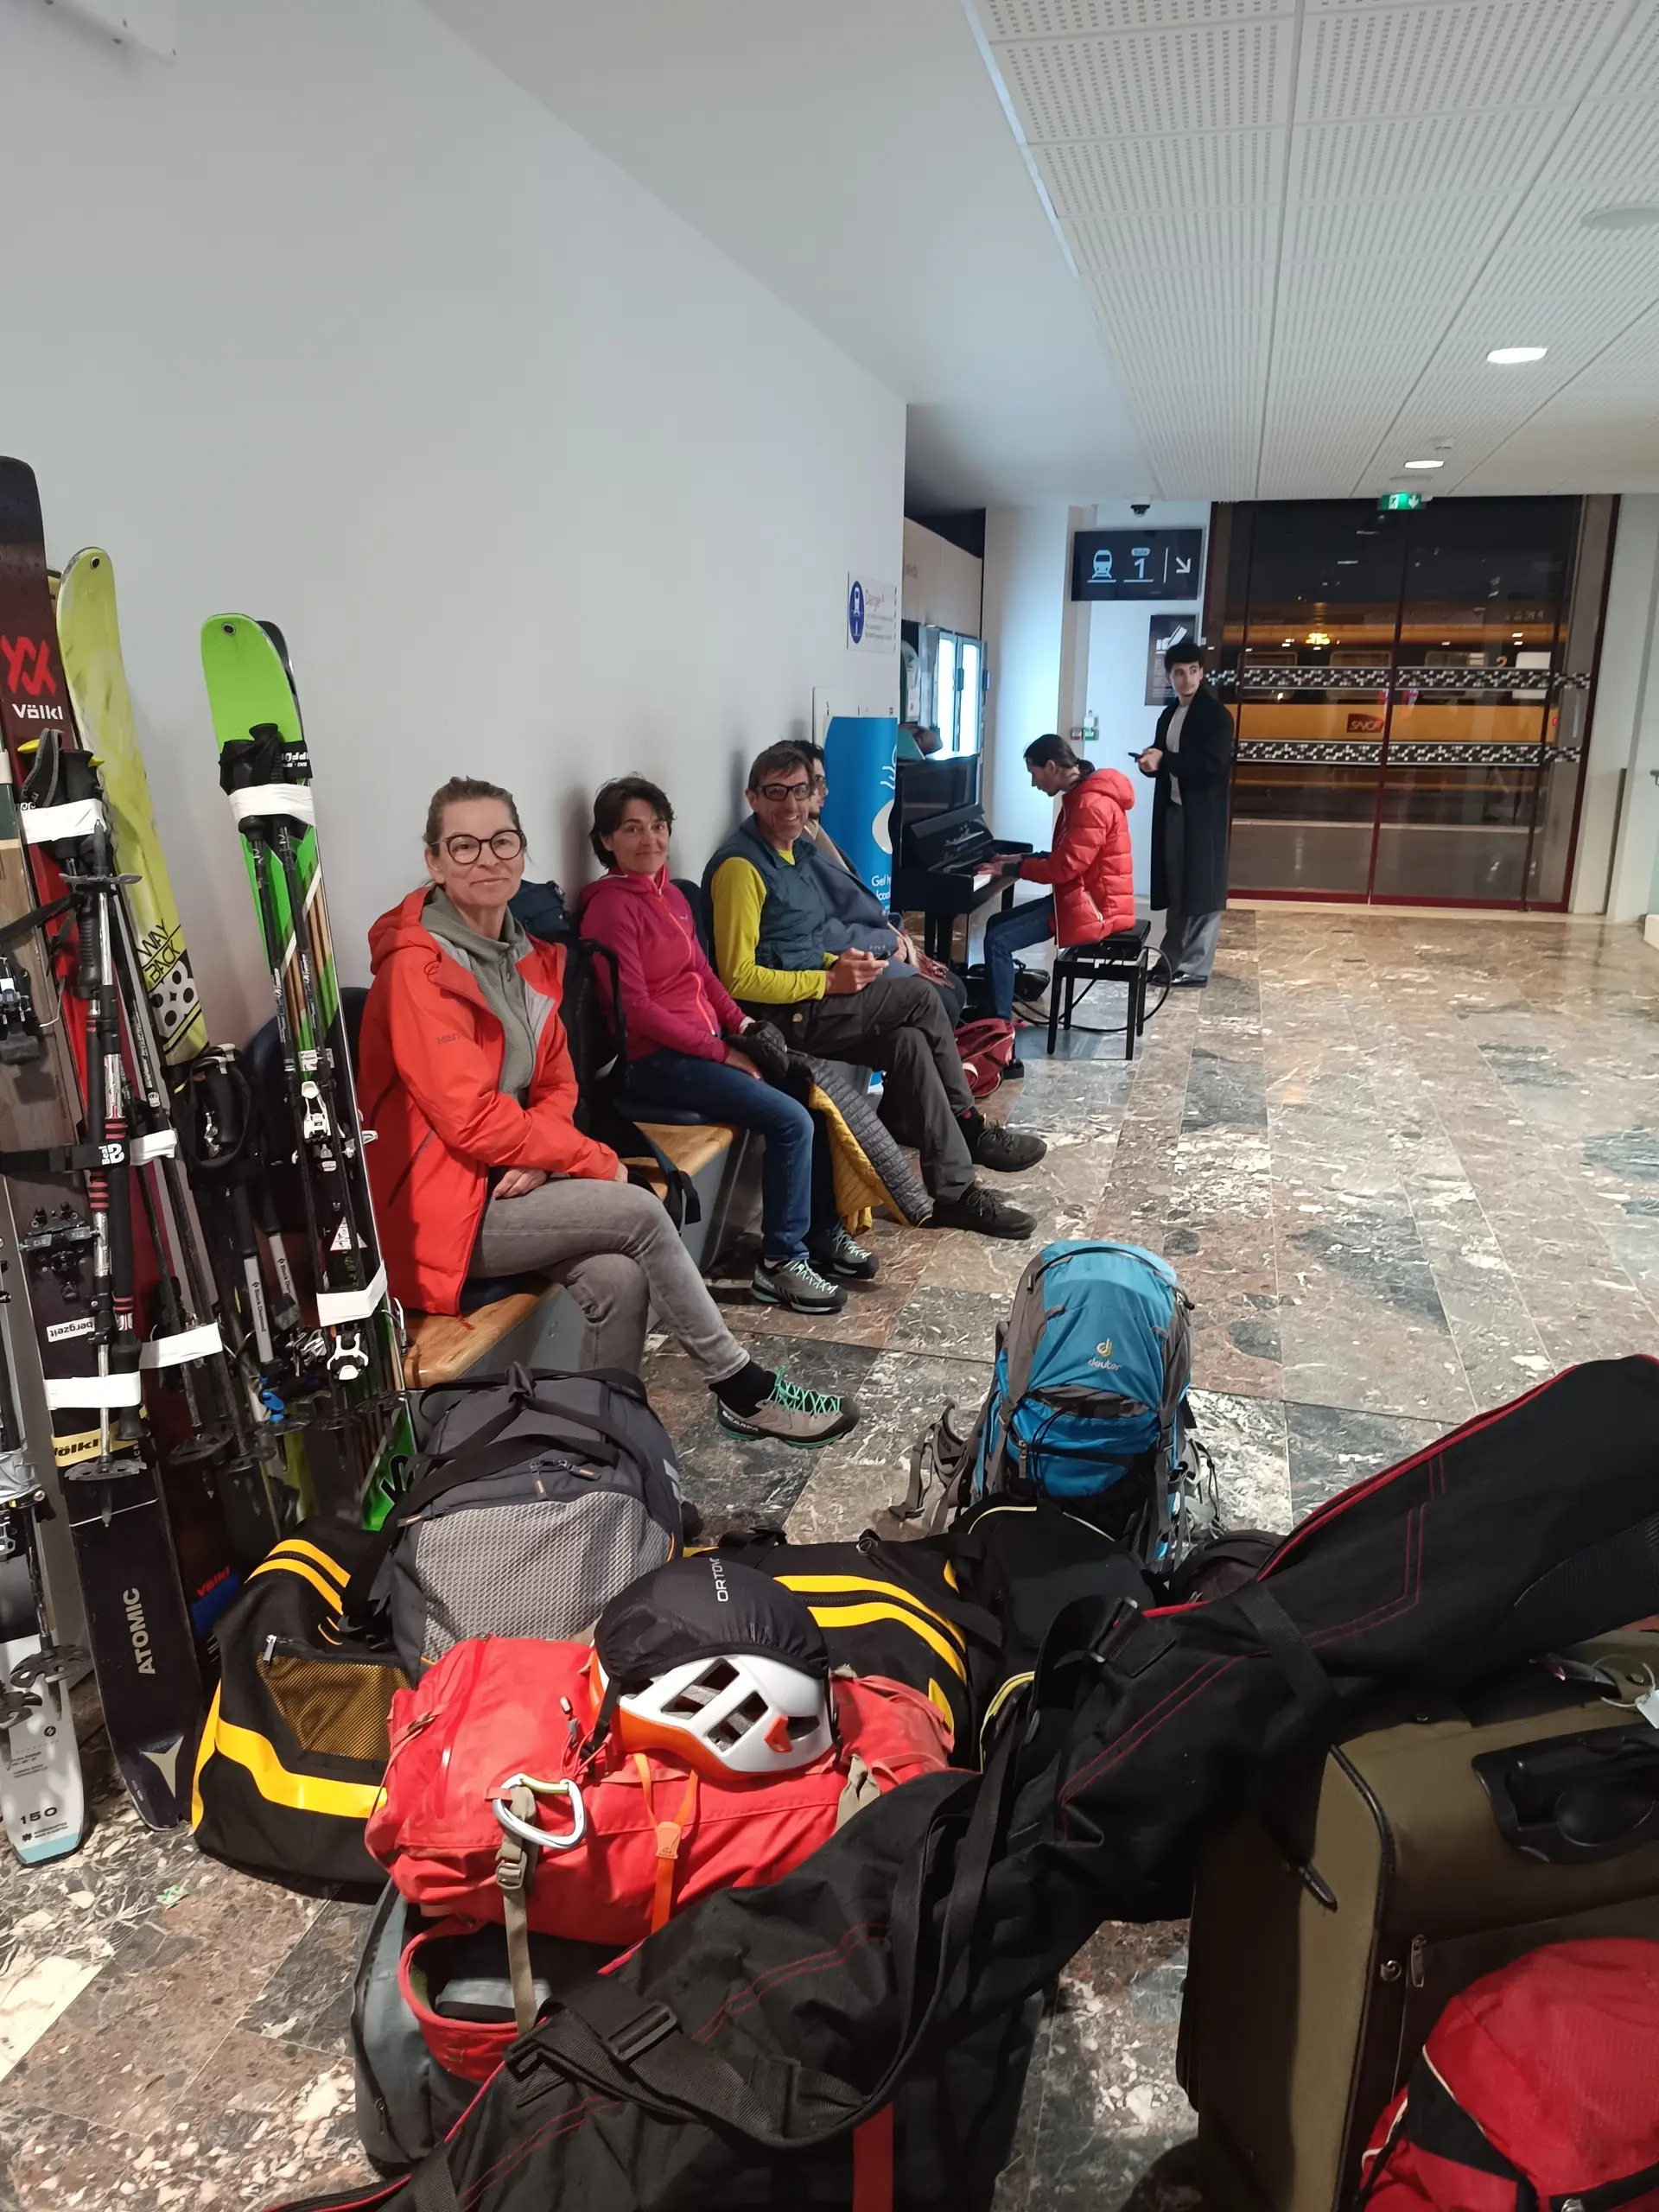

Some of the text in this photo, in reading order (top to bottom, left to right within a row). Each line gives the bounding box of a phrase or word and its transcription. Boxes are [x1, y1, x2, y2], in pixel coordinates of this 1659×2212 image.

[1134, 557, 1146, 579] 1
[12, 703, 64, 720] Völkl
[871, 874, 887, 887] Gel
[137, 918, 168, 957] WAY
[144, 939, 181, 984] BACK
[99, 1146, 111, 1165] Beal
[257, 1306, 266, 1332] Diamond
[49, 1321, 93, 1338] bergzeit
[1088, 1357, 1122, 1371] deuter
[123, 1586, 156, 1675] ATOMIC
[20, 1806, 58, 1825] 150
